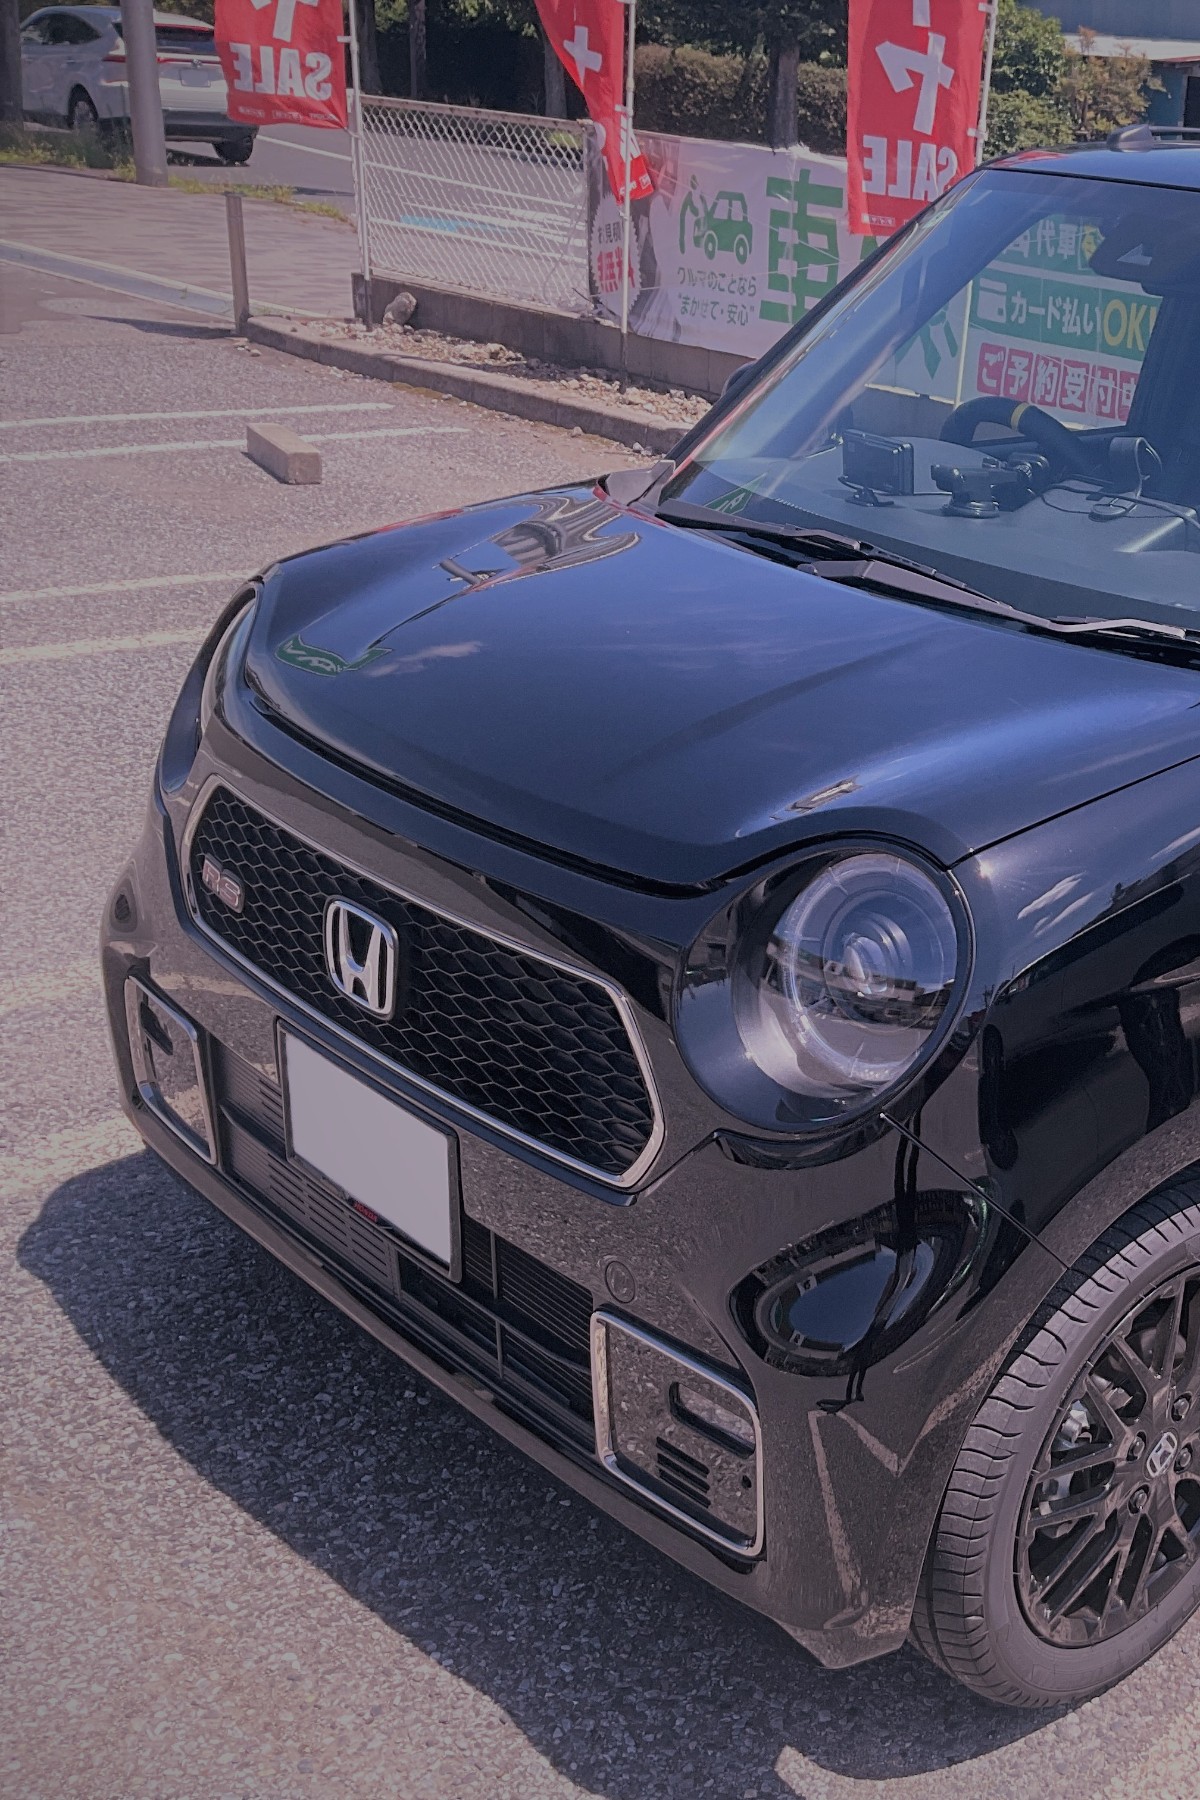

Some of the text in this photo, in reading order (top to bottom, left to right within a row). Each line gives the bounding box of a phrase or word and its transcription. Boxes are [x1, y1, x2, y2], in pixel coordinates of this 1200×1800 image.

[677, 266, 757, 297] クルマのことなら
[202, 858, 242, 909] RS
